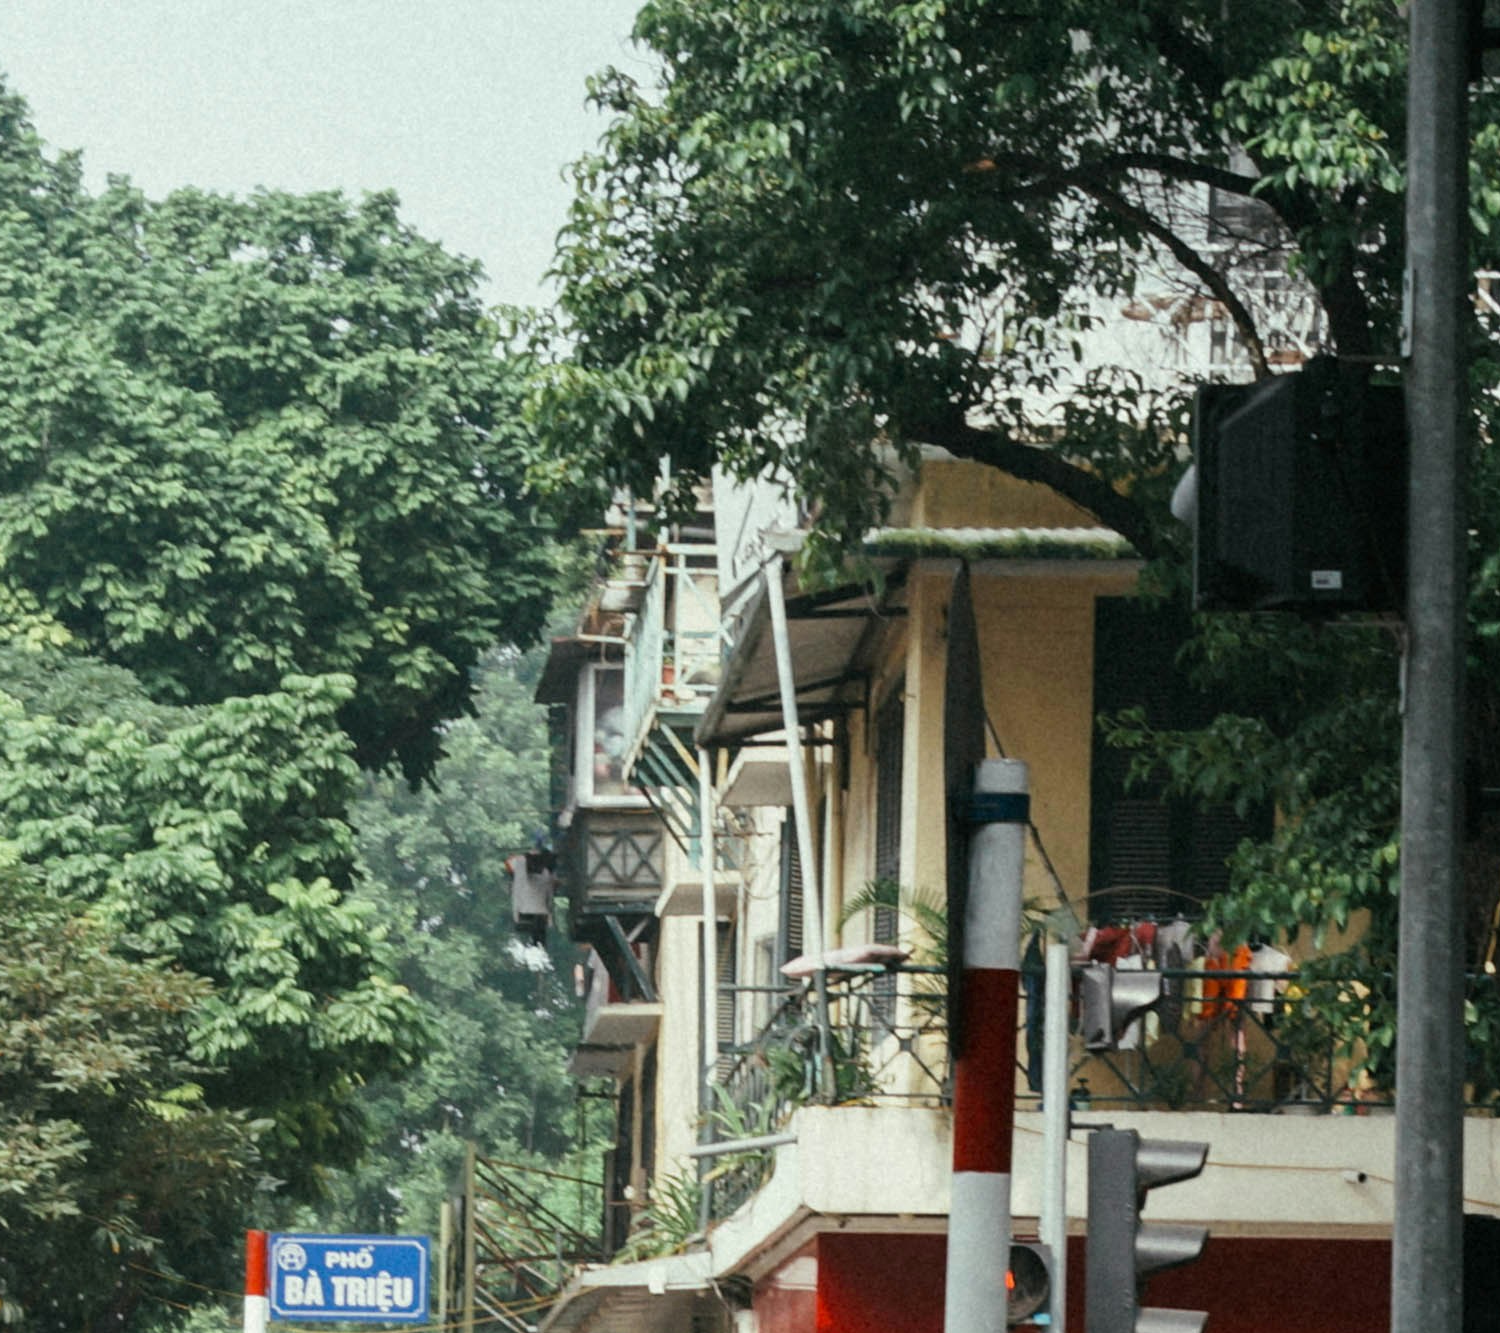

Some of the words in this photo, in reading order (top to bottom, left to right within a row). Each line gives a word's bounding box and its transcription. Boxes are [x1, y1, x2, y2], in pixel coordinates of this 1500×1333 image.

[324, 1245, 375, 1269] PHỐ
[284, 1269, 325, 1306] BÀ
[330, 1270, 414, 1313] TRIỆU
